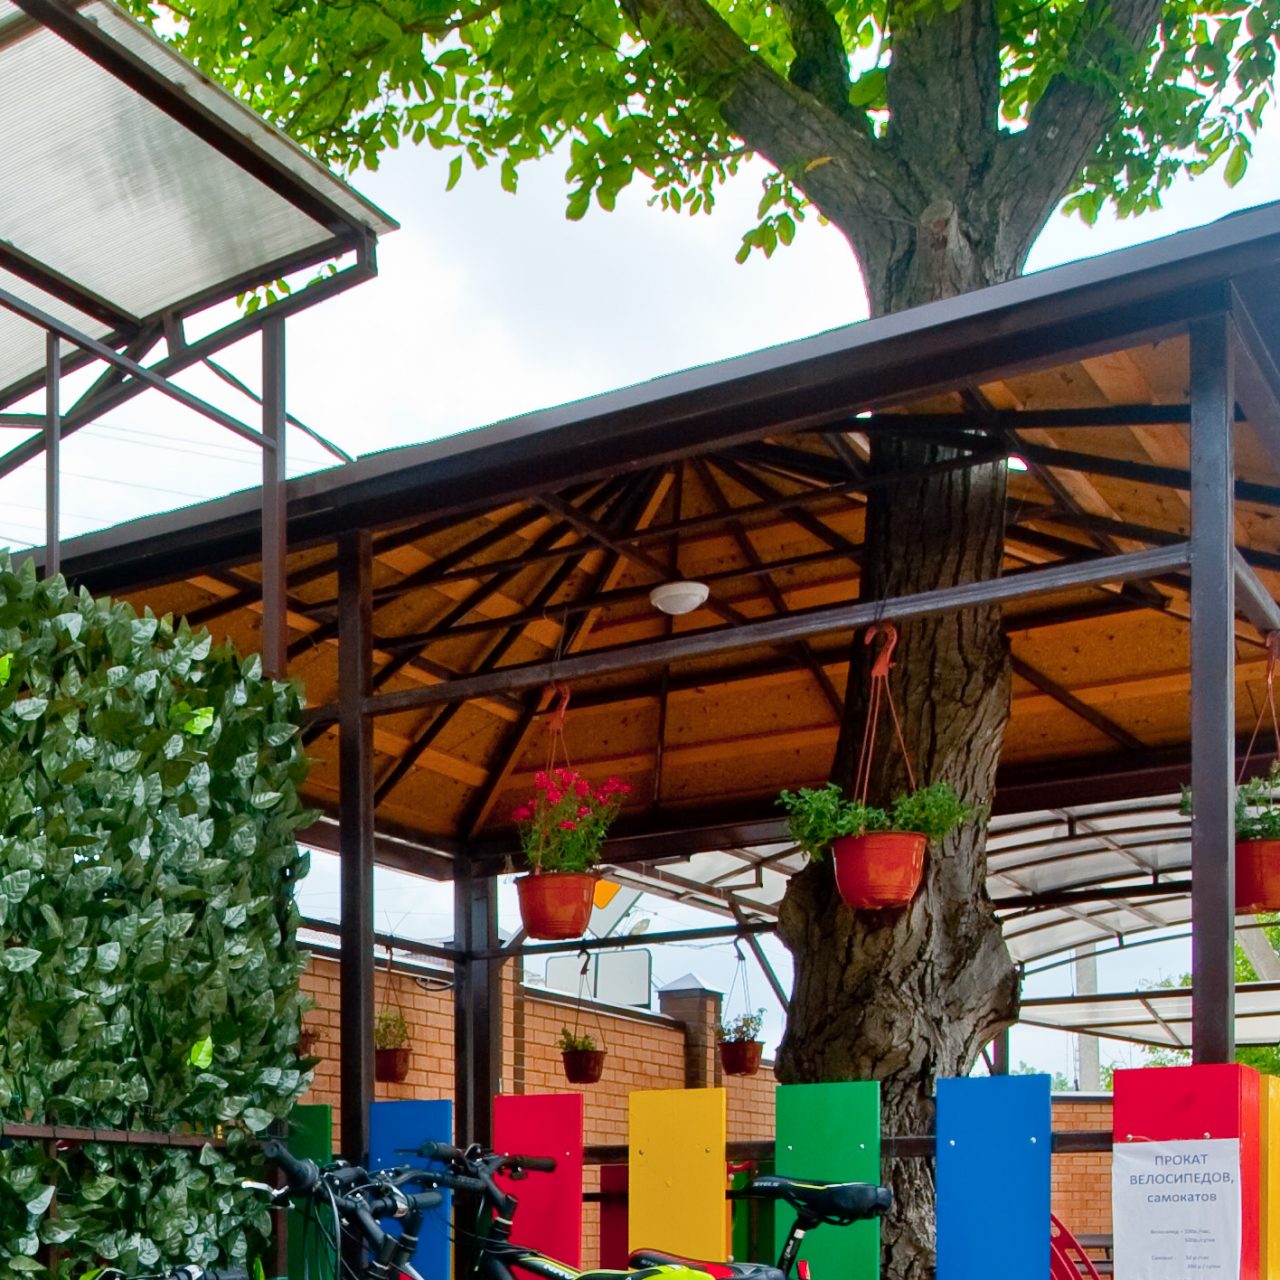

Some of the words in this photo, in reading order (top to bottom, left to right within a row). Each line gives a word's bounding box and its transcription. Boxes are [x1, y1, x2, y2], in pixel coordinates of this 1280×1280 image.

[1155, 1154, 1208, 1166] ПРОКАТ
[1130, 1172, 1234, 1185] ВЕЛОСИПЕДОВ,
[1147, 1193, 1217, 1203] самокатов
